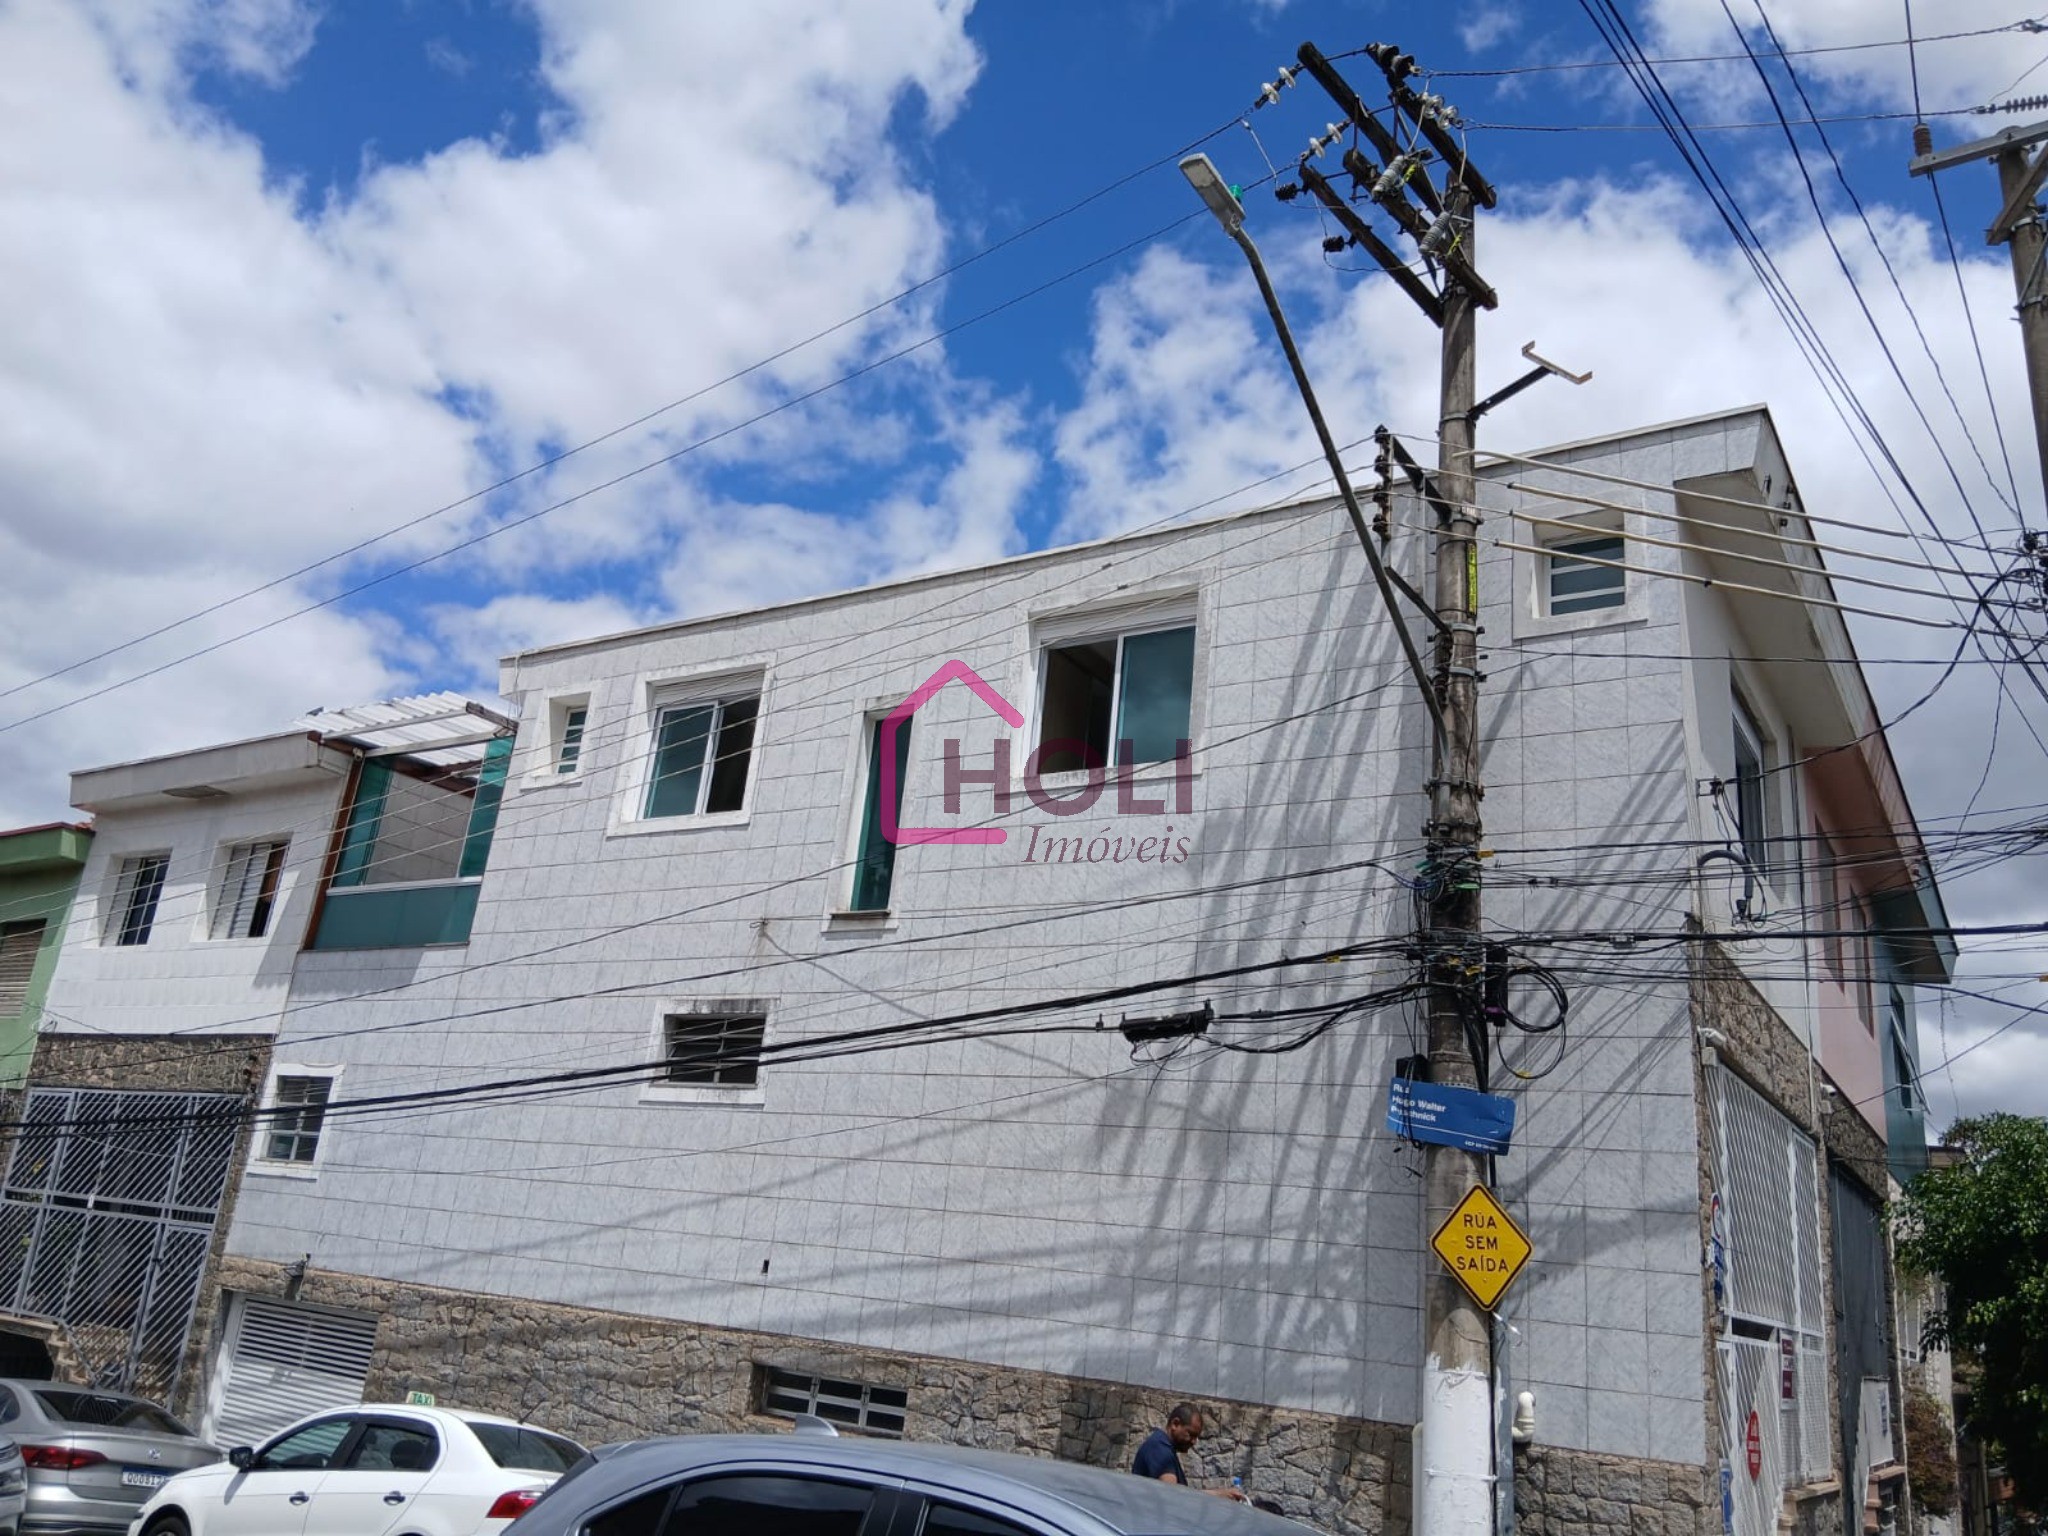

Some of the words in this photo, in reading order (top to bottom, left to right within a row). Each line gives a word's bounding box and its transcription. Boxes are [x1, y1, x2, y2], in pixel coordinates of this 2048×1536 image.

[1417, 1099, 1447, 1112] Walter
[1463, 1213, 1497, 1229] RUA
[1465, 1235, 1498, 1250] SEM
[1456, 1255, 1509, 1273] SAÍDA
[412, 1393, 432, 1404] TAXI
